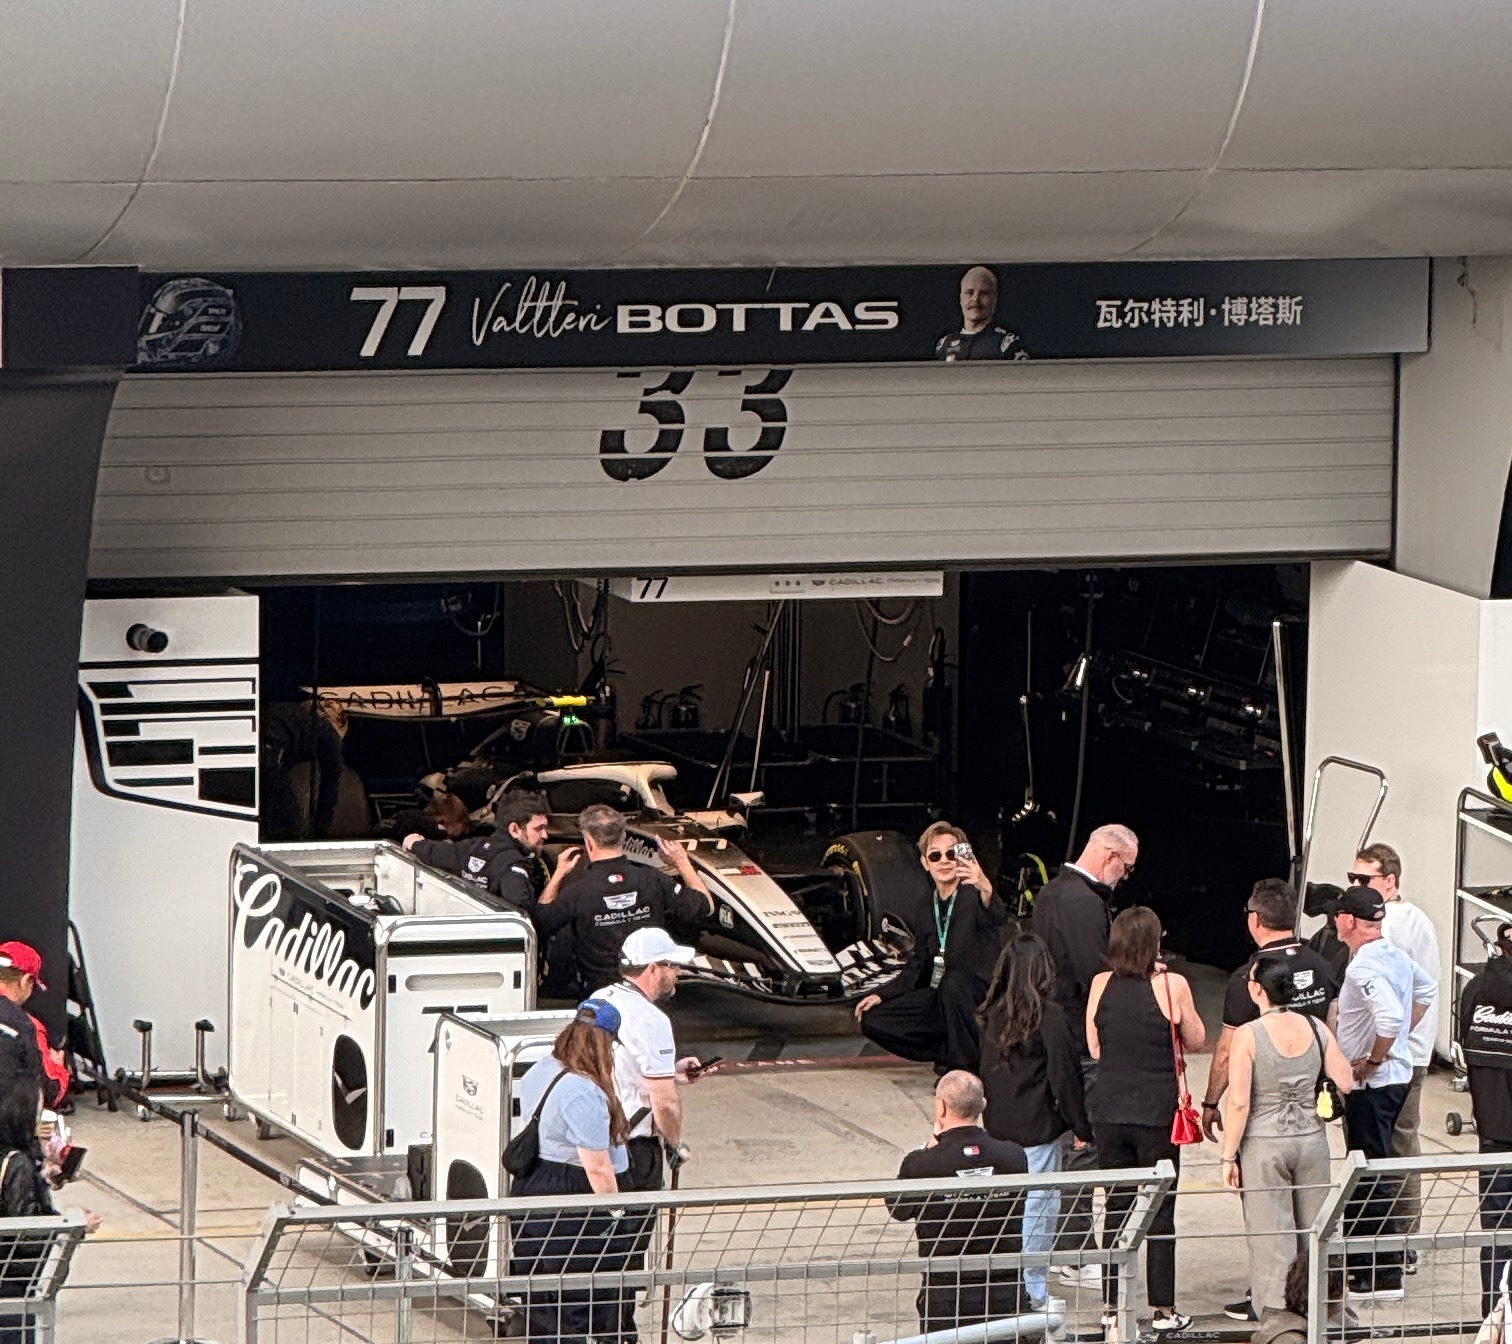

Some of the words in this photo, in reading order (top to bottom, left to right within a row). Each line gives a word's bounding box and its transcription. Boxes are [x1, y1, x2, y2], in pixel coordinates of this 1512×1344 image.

[350, 286, 447, 357] 77
[471, 275, 612, 346] Valtteri
[616, 301, 899, 334] BOTTAS
[1095, 295, 1303, 329] 瓦尔特利·博塔斯
[600, 369, 794, 481] 33
[636, 576, 669, 599] 77
[234, 862, 377, 1011] Cadillac
